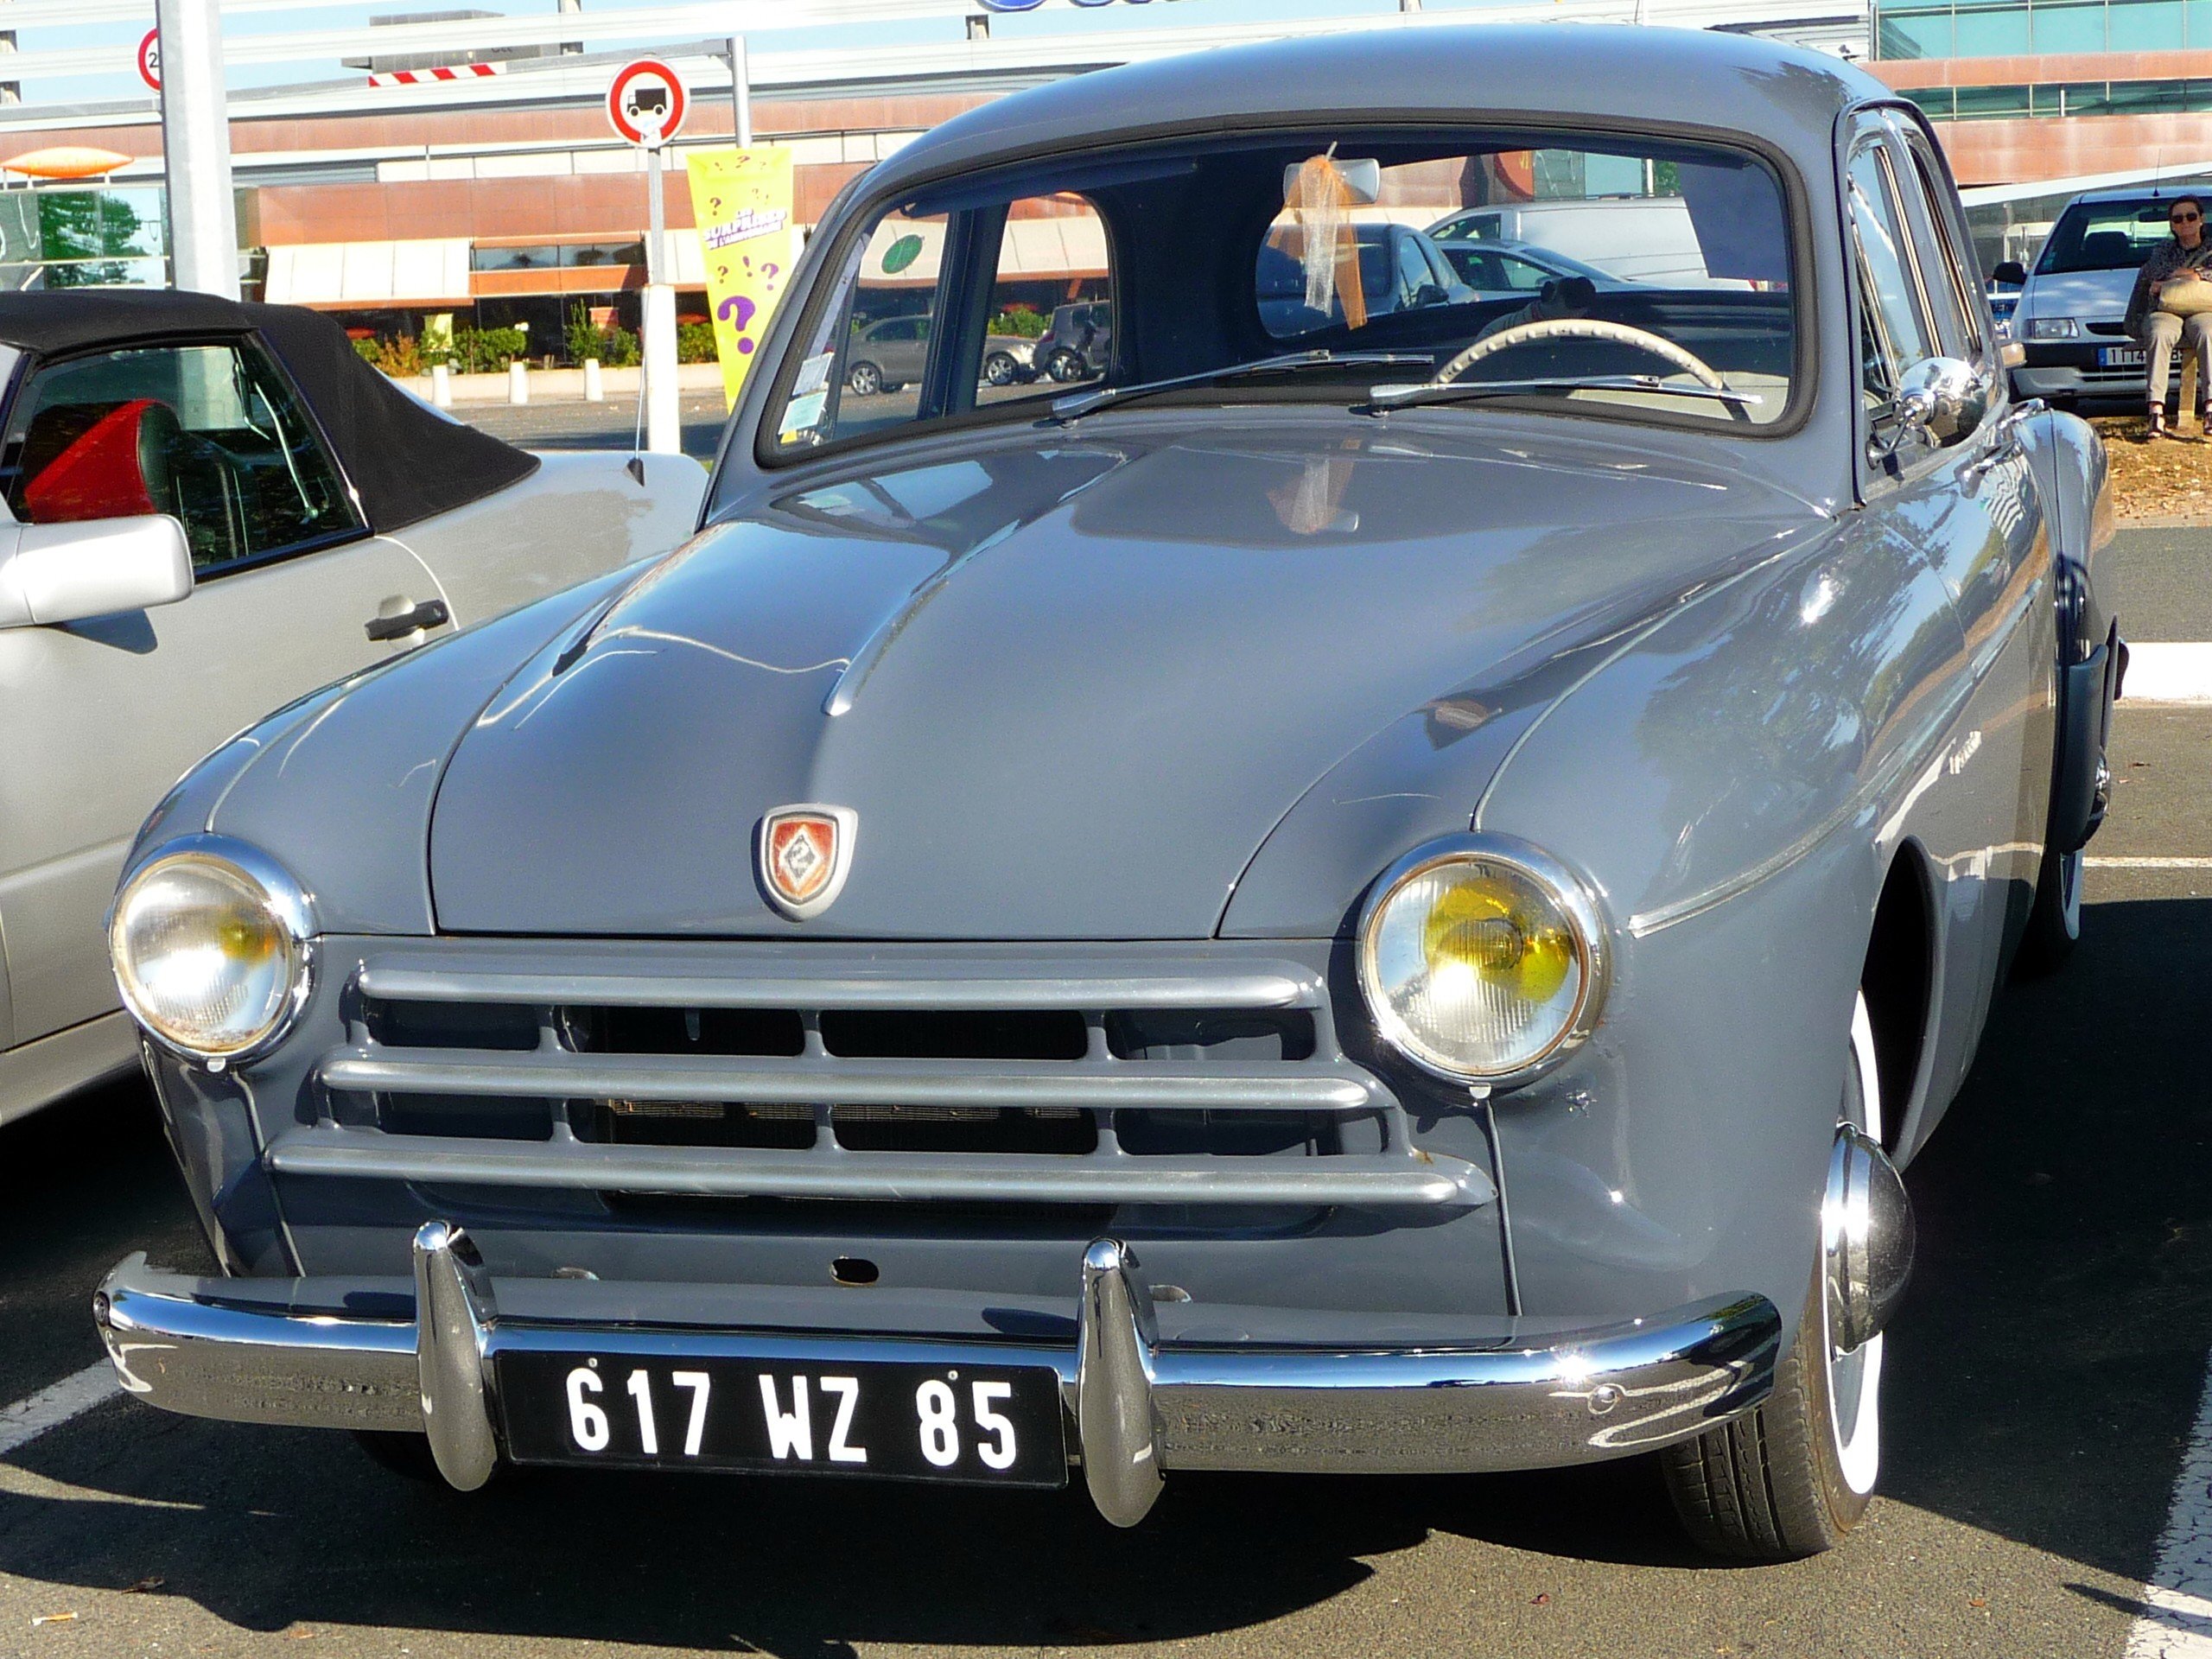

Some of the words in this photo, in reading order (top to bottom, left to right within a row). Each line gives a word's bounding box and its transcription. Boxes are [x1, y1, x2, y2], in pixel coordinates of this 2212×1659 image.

[564, 1367, 711, 1457] 617
[759, 1374, 867, 1464] WZ
[914, 1380, 1018, 1471] 85
